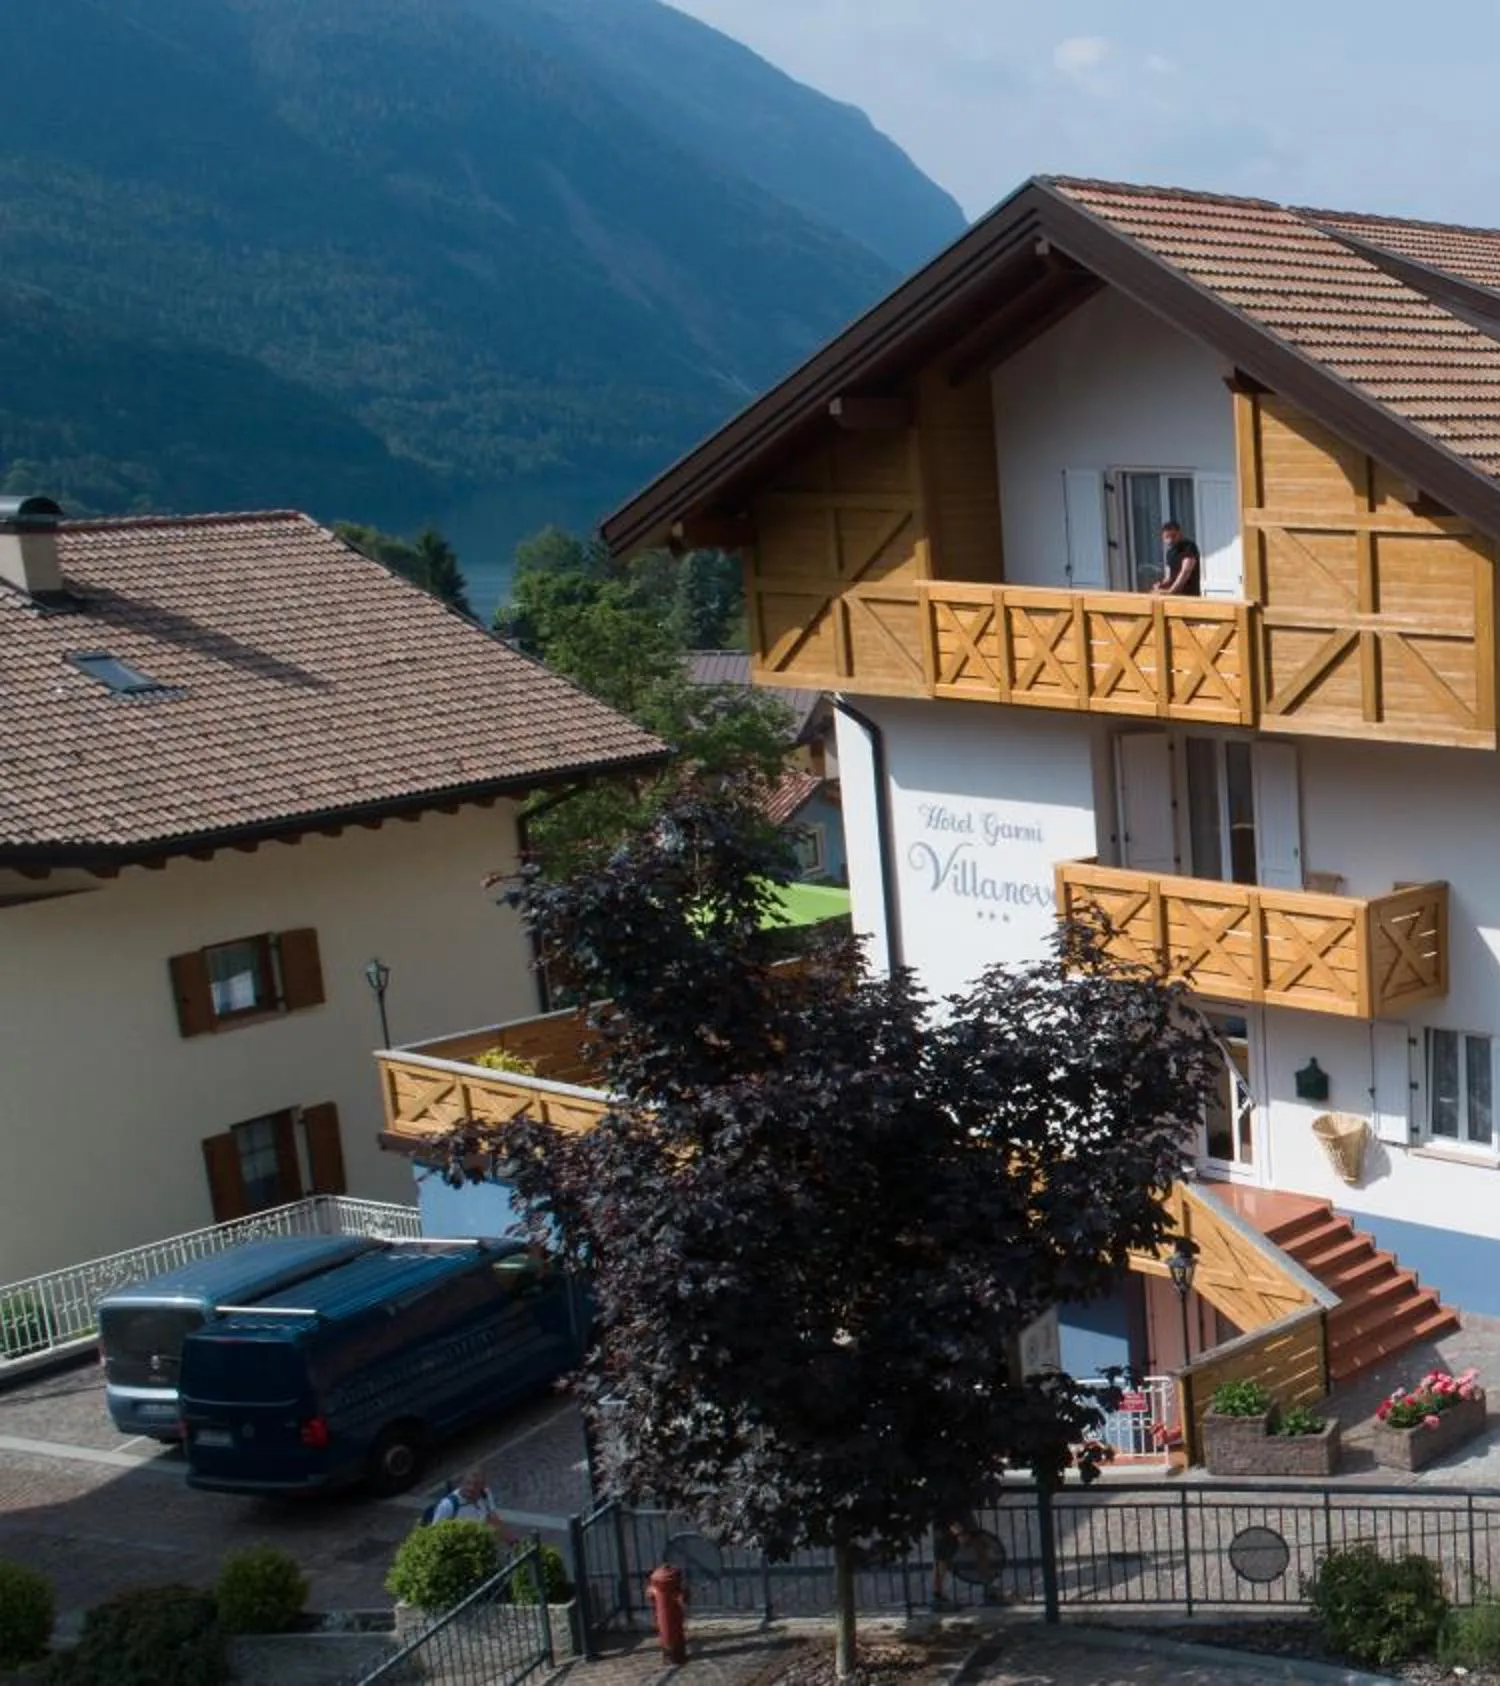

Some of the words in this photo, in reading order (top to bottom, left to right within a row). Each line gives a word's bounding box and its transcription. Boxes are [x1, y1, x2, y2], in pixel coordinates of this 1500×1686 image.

[918, 804, 975, 833] Hotel
[982, 812, 1045, 846] Garni
[908, 841, 1056, 907] Villanov
